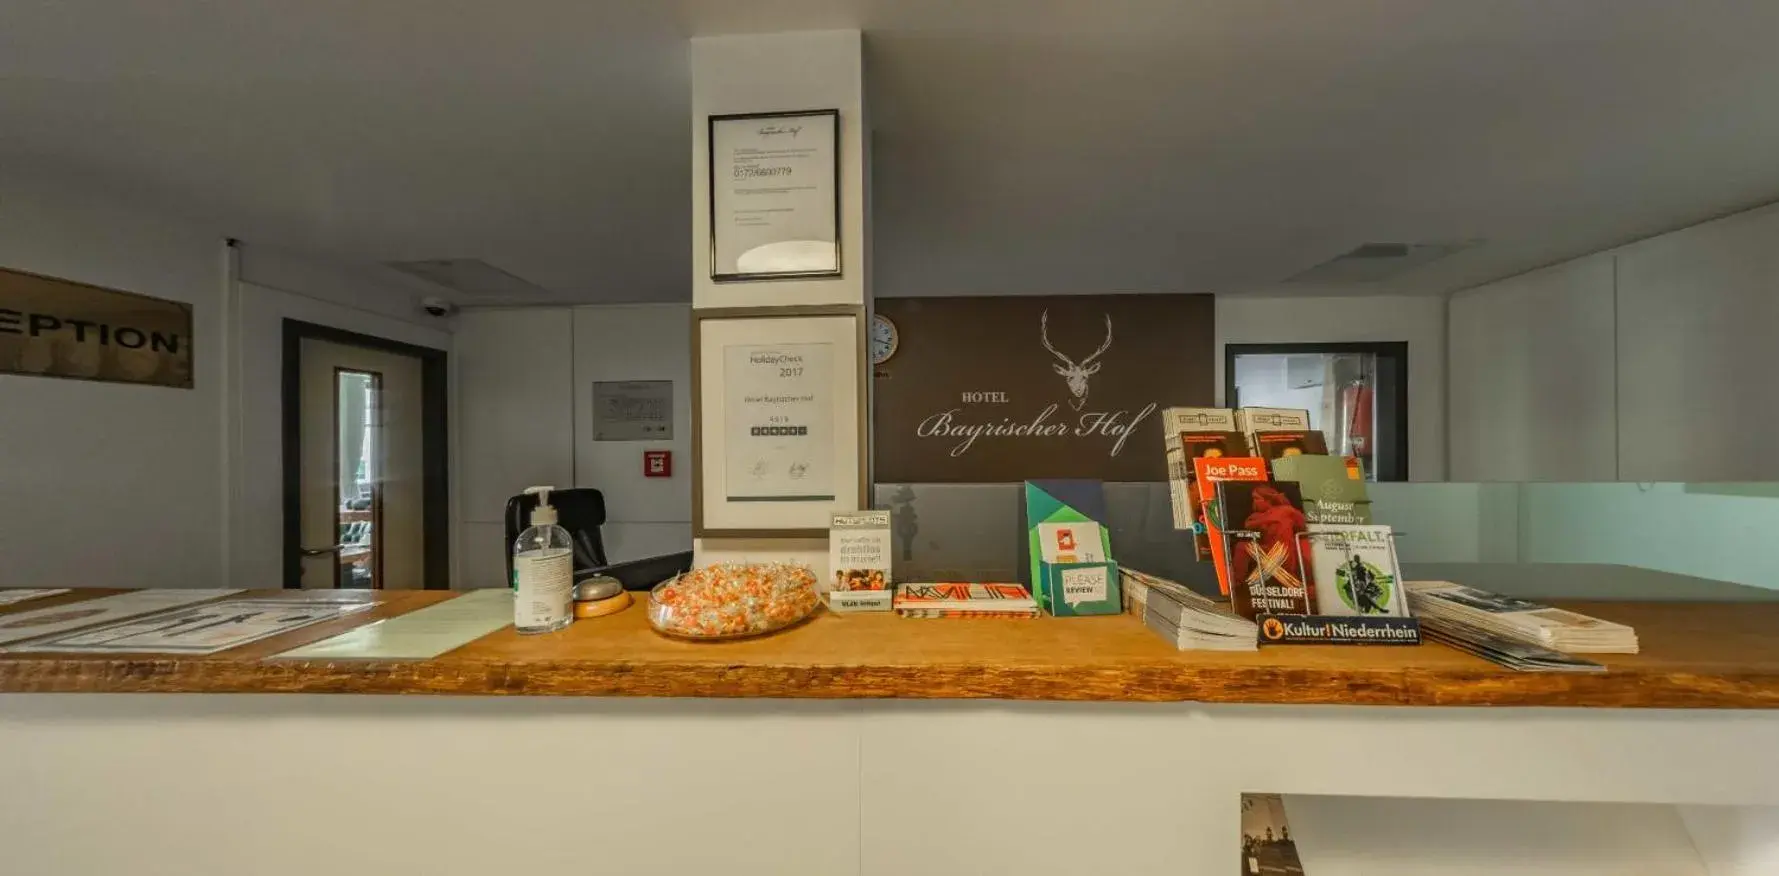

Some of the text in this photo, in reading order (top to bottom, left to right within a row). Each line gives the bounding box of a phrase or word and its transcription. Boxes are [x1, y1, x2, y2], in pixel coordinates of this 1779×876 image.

[779, 367, 804, 377] 2017
[962, 391, 1009, 403] HOTEL
[917, 402, 1157, 457] Bayrischer Hof
[1205, 464, 1258, 476] Joe Pass
[1317, 499, 1354, 512] August
[1065, 586, 1093, 594] REVIEW
